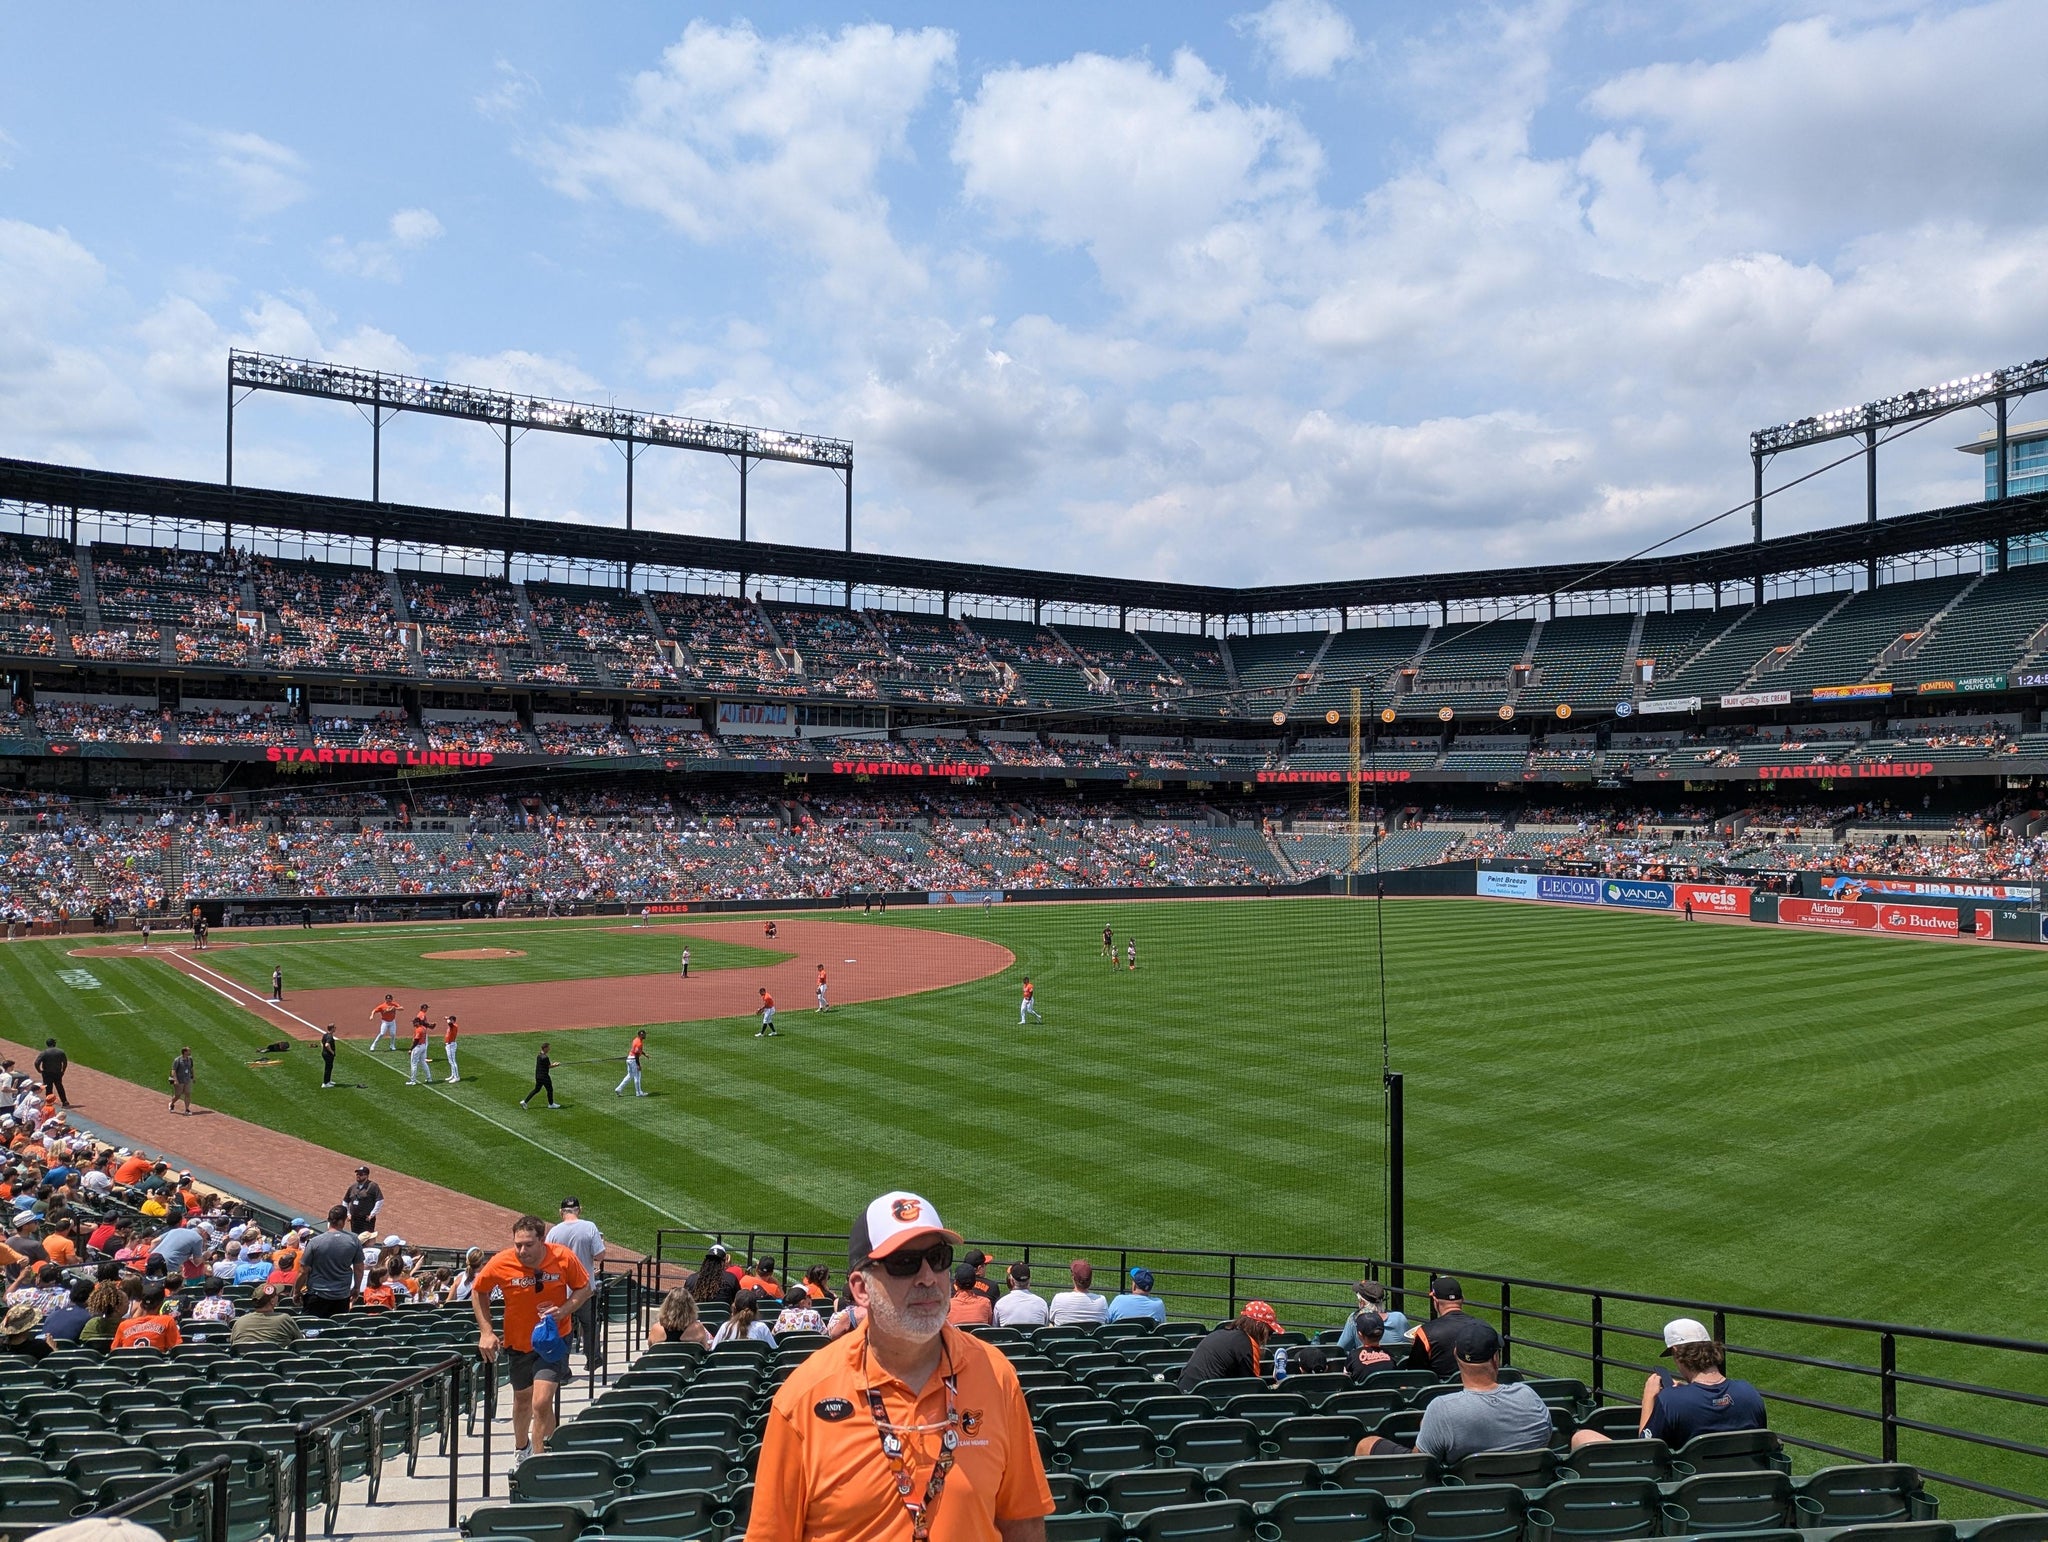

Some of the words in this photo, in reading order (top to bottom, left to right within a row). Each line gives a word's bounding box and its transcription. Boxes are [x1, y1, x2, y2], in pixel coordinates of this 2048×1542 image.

[1920, 681, 1954, 692] POMPEIAN
[1958, 677, 1993, 685] AMERICA'S
[1771, 694, 1788, 702] CREAM
[1442, 710, 1451, 718] 22
[1501, 709, 1511, 717] 33
[1617, 705, 1629, 714] 42
[266, 747, 397, 763] STARTING
[406, 751, 494, 766] LINEUP
[832, 762, 923, 775] STARTING
[929, 764, 990, 777] LINEUP
[1758, 765, 1852, 779] STARTING
[1858, 763, 1933, 777] LINEUP
[1257, 771, 1341, 782] STARTING
[1487, 875, 1503, 883] Point
[1504, 876, 1527, 884] Breeze
[1542, 880, 1595, 895] LECOM
[1915, 883, 1951, 895] BIRD
[1954, 885, 1994, 897] BATH
[1621, 888, 1667, 901] VANDA
[1692, 889, 1736, 906] weis
[645, 904, 688, 912] ORIOLES
[1811, 902, 1844, 915] Airtemp
[2002, 911, 2017, 920] 376
[825, 1403, 843, 1411] ANDY
